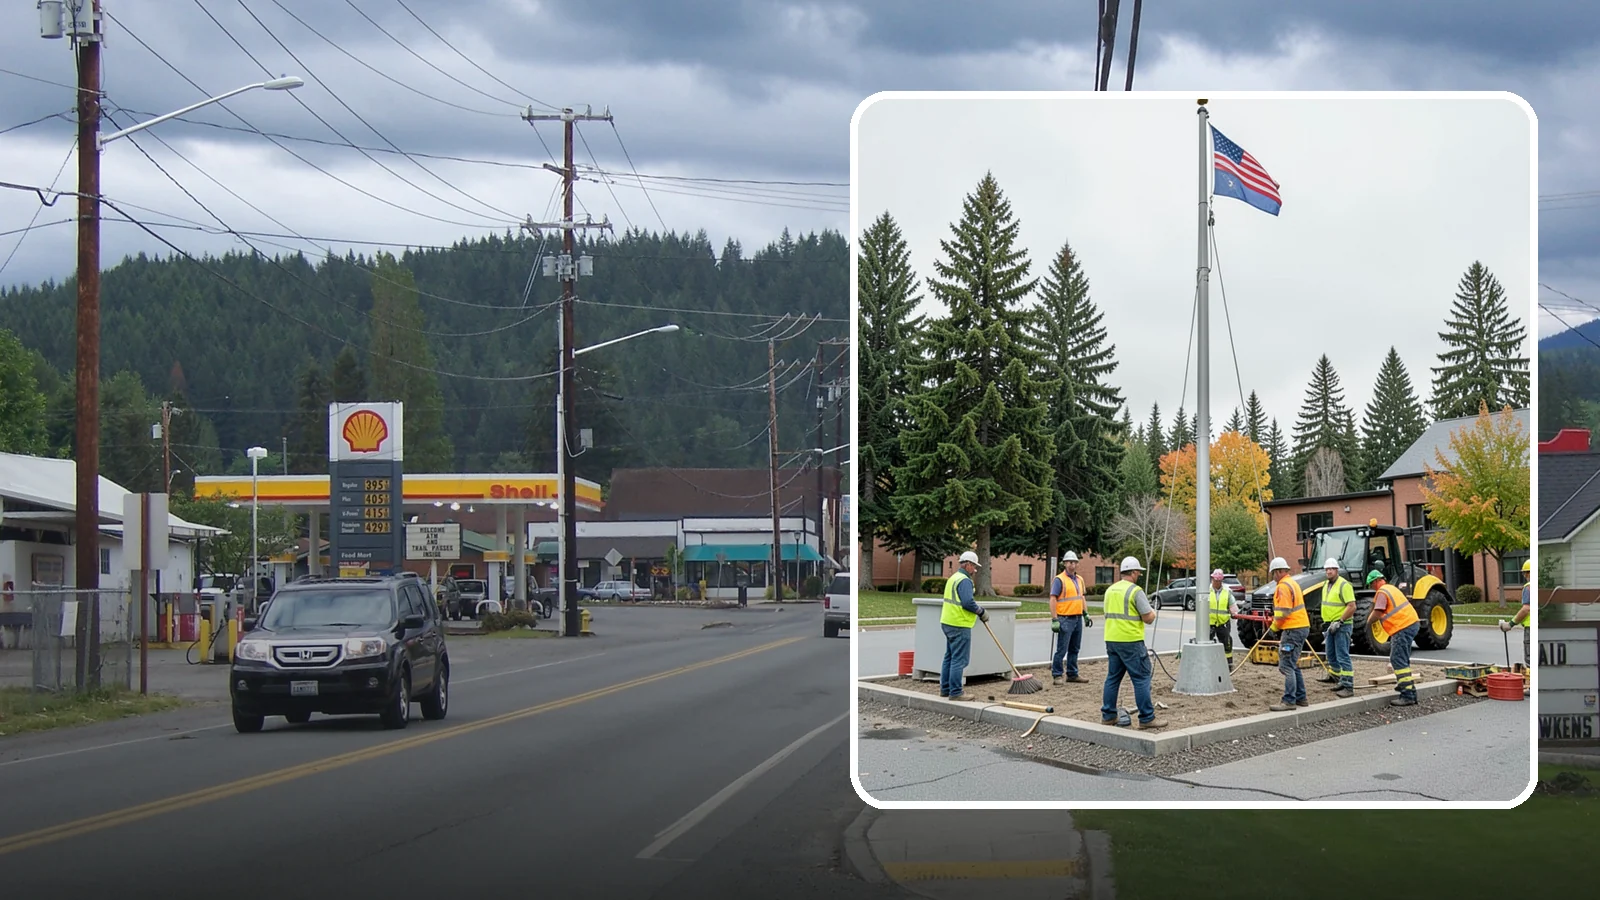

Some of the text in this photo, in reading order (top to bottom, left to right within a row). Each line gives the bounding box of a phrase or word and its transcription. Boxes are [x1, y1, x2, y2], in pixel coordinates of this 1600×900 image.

[366, 480, 383, 490] 395
[490, 484, 547, 499] Shell
[366, 494, 383, 504] 405
[366, 508, 383, 518] 415
[366, 522, 383, 532] 429
